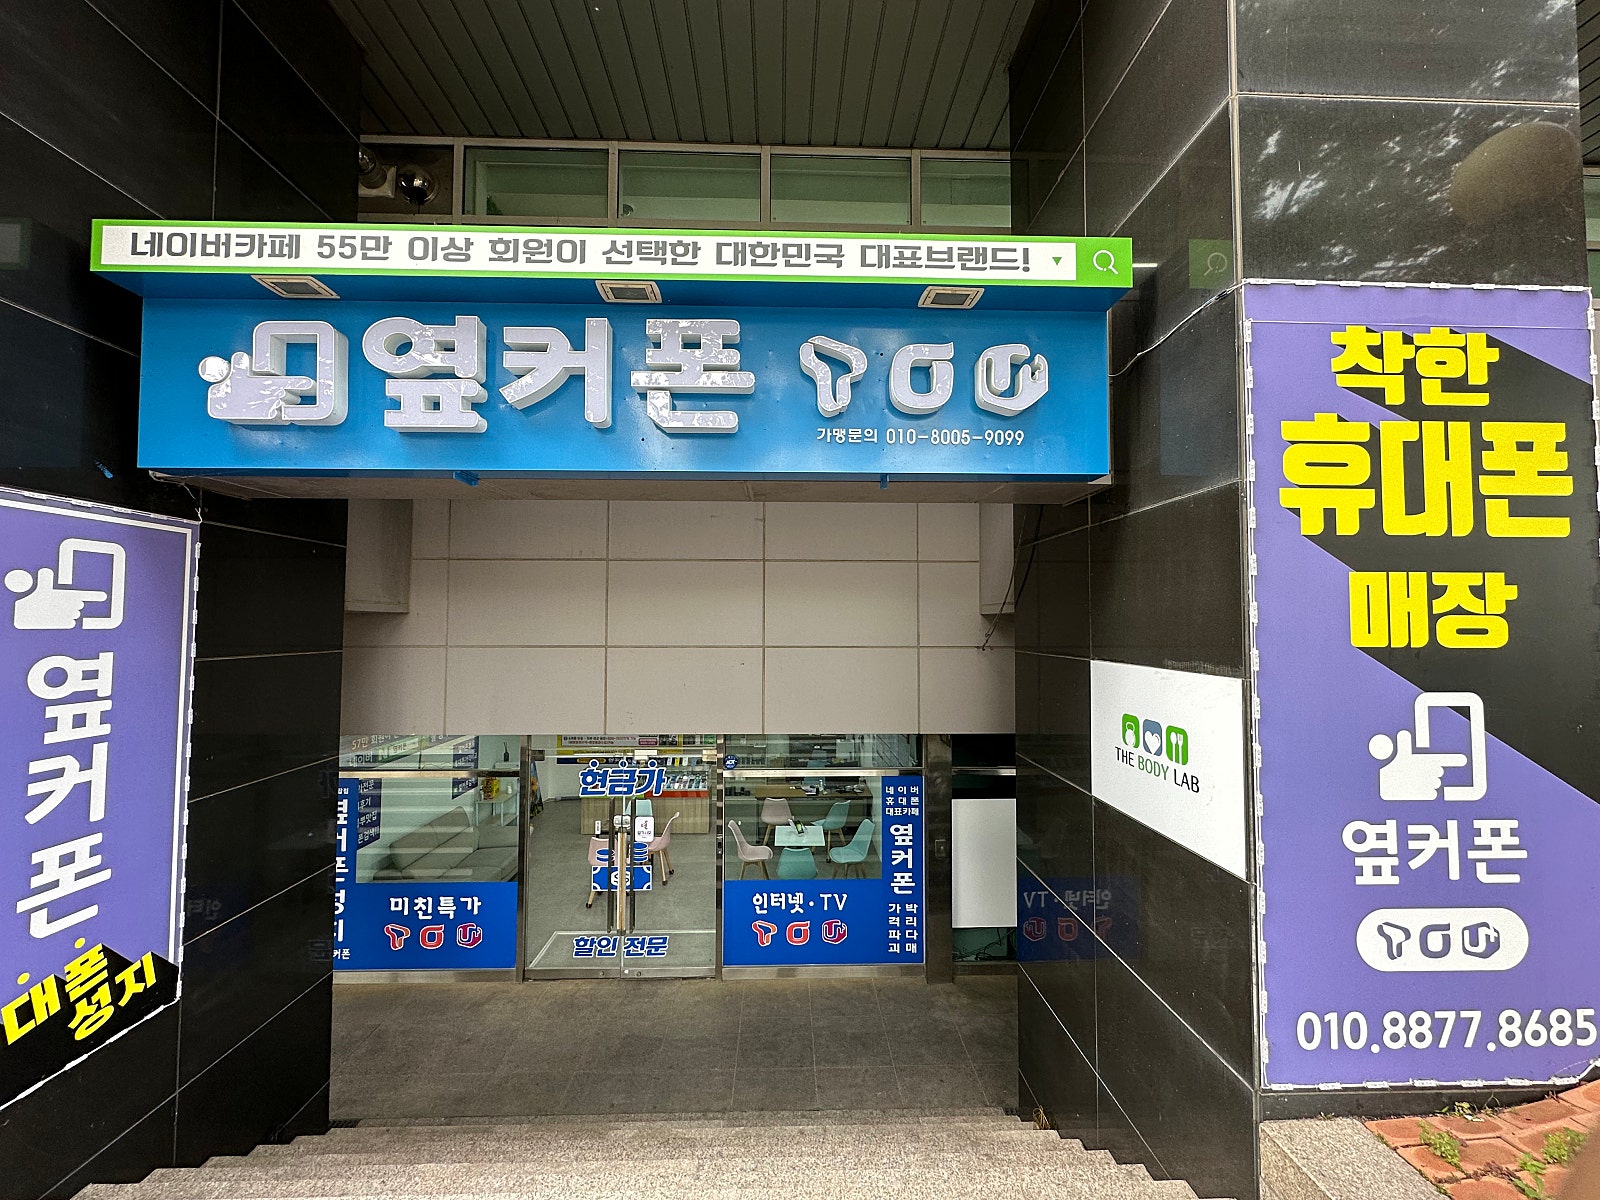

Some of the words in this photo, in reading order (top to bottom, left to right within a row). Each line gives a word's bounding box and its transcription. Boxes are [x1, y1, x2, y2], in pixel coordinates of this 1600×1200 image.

[130, 232, 301, 259] 네이버카페
[317, 235, 393, 261] 55만
[407, 235, 474, 262] 이상
[488, 238, 587, 265] 회원이
[601, 240, 702, 267] 선택한
[716, 241, 845, 270] 대한민국
[861, 244, 1031, 273] 대표브랜드!
[361, 315, 756, 435] 옆커폰
[1331, 325, 1500, 407] 착한
[816, 428, 879, 445] 가맹문의
[885, 429, 1026, 448] 010-8005-9099
[1279, 413, 1574, 538] 휴대폰
[1349, 572, 1518, 648] 매장
[578, 766, 668, 797] 현금가
[885, 785, 919, 795] 네이버
[1115, 746, 1135, 768] THE
[1137, 755, 1169, 781] BODY
[1173, 768, 1200, 793] LAB
[16, 652, 114, 939] 옆커폰
[885, 796, 919, 806] 휴대폰
[885, 807, 920, 817] 대표카페
[889, 823, 916, 895] 옆커폰
[1341, 819, 1528, 886] 옆커폰
[389, 896, 482, 920] 미친특가
[888, 904, 901, 953] 가격파괴
[905, 904, 918, 953] 박리다매
[573, 935, 619, 958] 할인
[622, 935, 669, 958] 전문
[1296, 1008, 1599, 1054] 010.8877.8685
